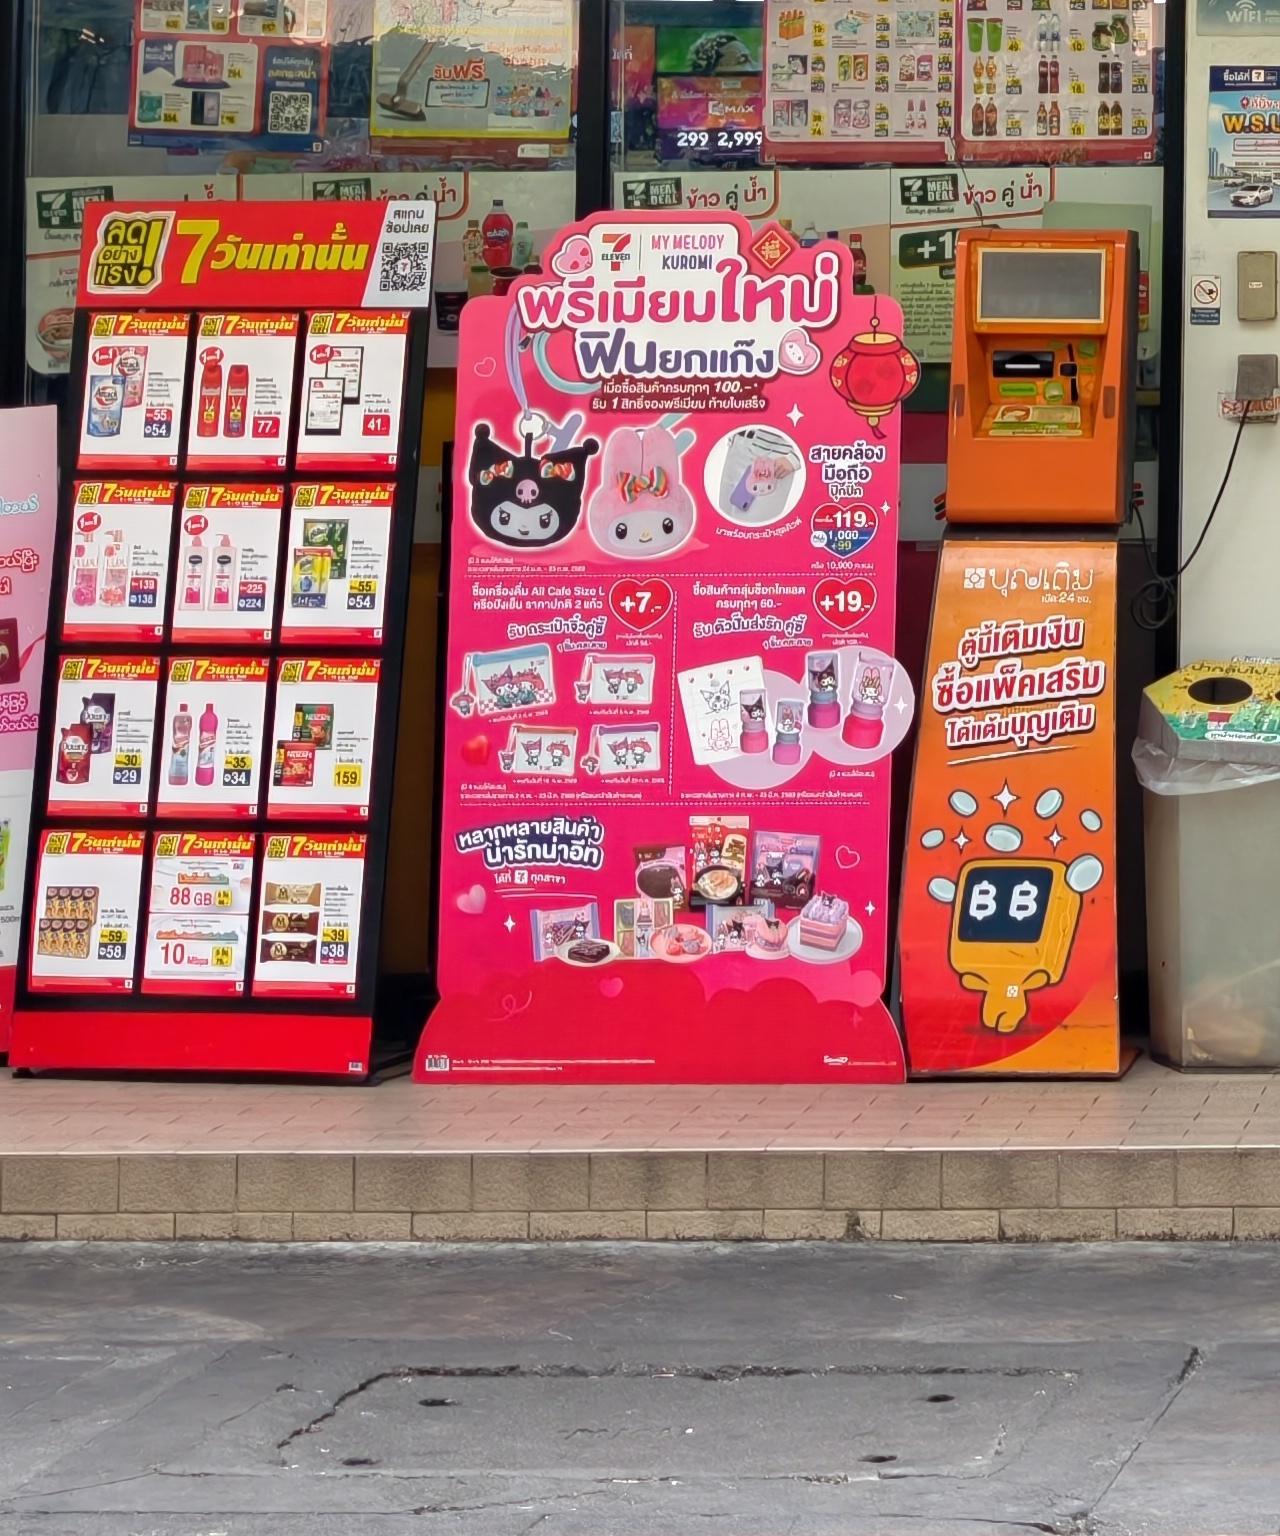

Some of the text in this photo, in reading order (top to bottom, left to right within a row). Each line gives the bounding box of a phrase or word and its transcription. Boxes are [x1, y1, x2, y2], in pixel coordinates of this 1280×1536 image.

[677, 131, 709, 147] 299
[649, 182, 677, 194] MEAL
[926, 180, 954, 192] MEAL
[1001, 181, 1015, 207] คู่
[1019, 173, 1043, 201] น้ำ
[650, 192, 679, 206] DEAL
[686, 176, 767, 211] ข้าว คู่ น้ำ
[926, 190, 956, 203] DEAL
[393, 209, 424, 220] สแกน
[108, 219, 145, 244] ลด
[385, 221, 430, 234] ช้อปเลย
[651, 234, 725, 249] MY MELODY
[102, 244, 138, 262] อย่าง
[602, 233, 632, 272] 7
[662, 254, 713, 270] KUROMI
[521, 255, 839, 324] พรีเมียมใหม่
[579, 327, 774, 374] ฟินยกแก๊ง
[592, 398, 607, 410] รับ
[611, 399, 619, 410] 1
[153, 409, 168, 420] 55
[151, 423, 167, 435] 54
[257, 420, 273, 433] 77
[367, 418, 382, 431] 41
[810, 443, 885, 461] สายคล้อง
[824, 464, 870, 481] มือถือ
[358, 581, 372, 592] 55
[988, 561, 1094, 598] บุญเติม
[355, 595, 371, 608] 54
[1058, 593, 1075, 603] 24
[574, 601, 582, 610] 2
[960, 616, 1081, 664] ตู้นี้เติมเงิน
[936, 661, 1101, 708] ซื้อแพ็คเสริม
[947, 702, 1093, 744] ได้แต้มบุญเติม
[124, 754, 138, 766] 30
[233, 756, 246, 768] 35
[121, 769, 137, 783] 29
[230, 772, 246, 784] 34
[335, 770, 358, 784] 159
[458, 814, 600, 847] หลากหลายสินค้า
[169, 887, 213, 906] 88 GB
[108, 930, 122, 942] 59
[331, 929, 345, 941] 39
[106, 945, 122, 958] 58
[160, 943, 185, 965] 10
[329, 944, 345, 957] 38
